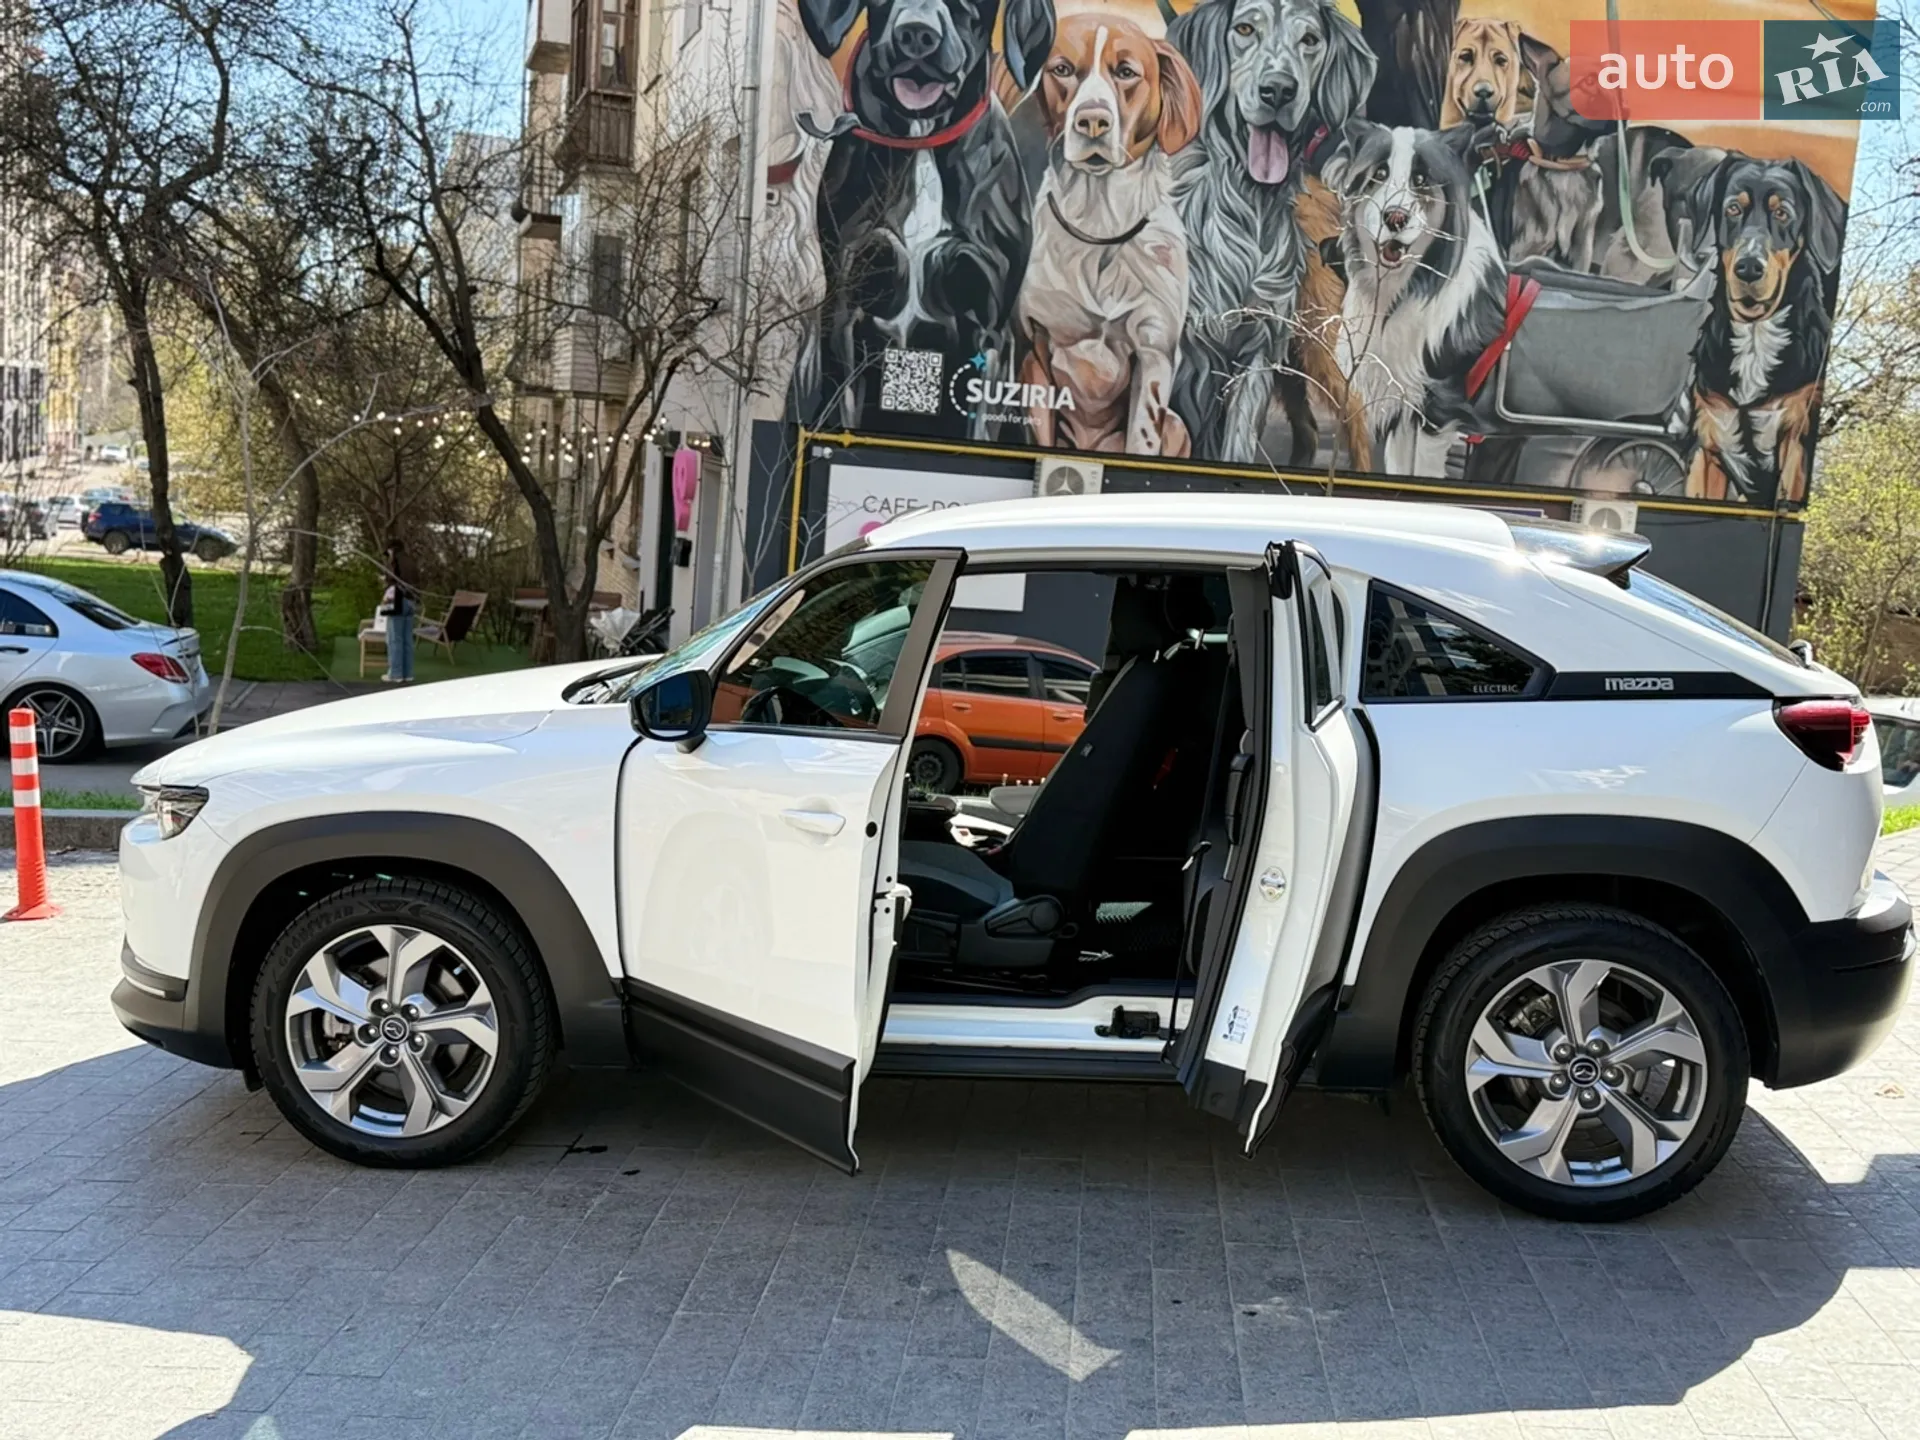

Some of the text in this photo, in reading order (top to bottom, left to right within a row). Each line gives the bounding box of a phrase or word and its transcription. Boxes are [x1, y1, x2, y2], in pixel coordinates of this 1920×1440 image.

[965, 377, 1076, 411] SUZIRIA
[981, 413, 1007, 423] goods
[1008, 413, 1021, 423] for
[1472, 684, 1519, 694] ELECTRIC
[1605, 677, 1674, 691] mazda
